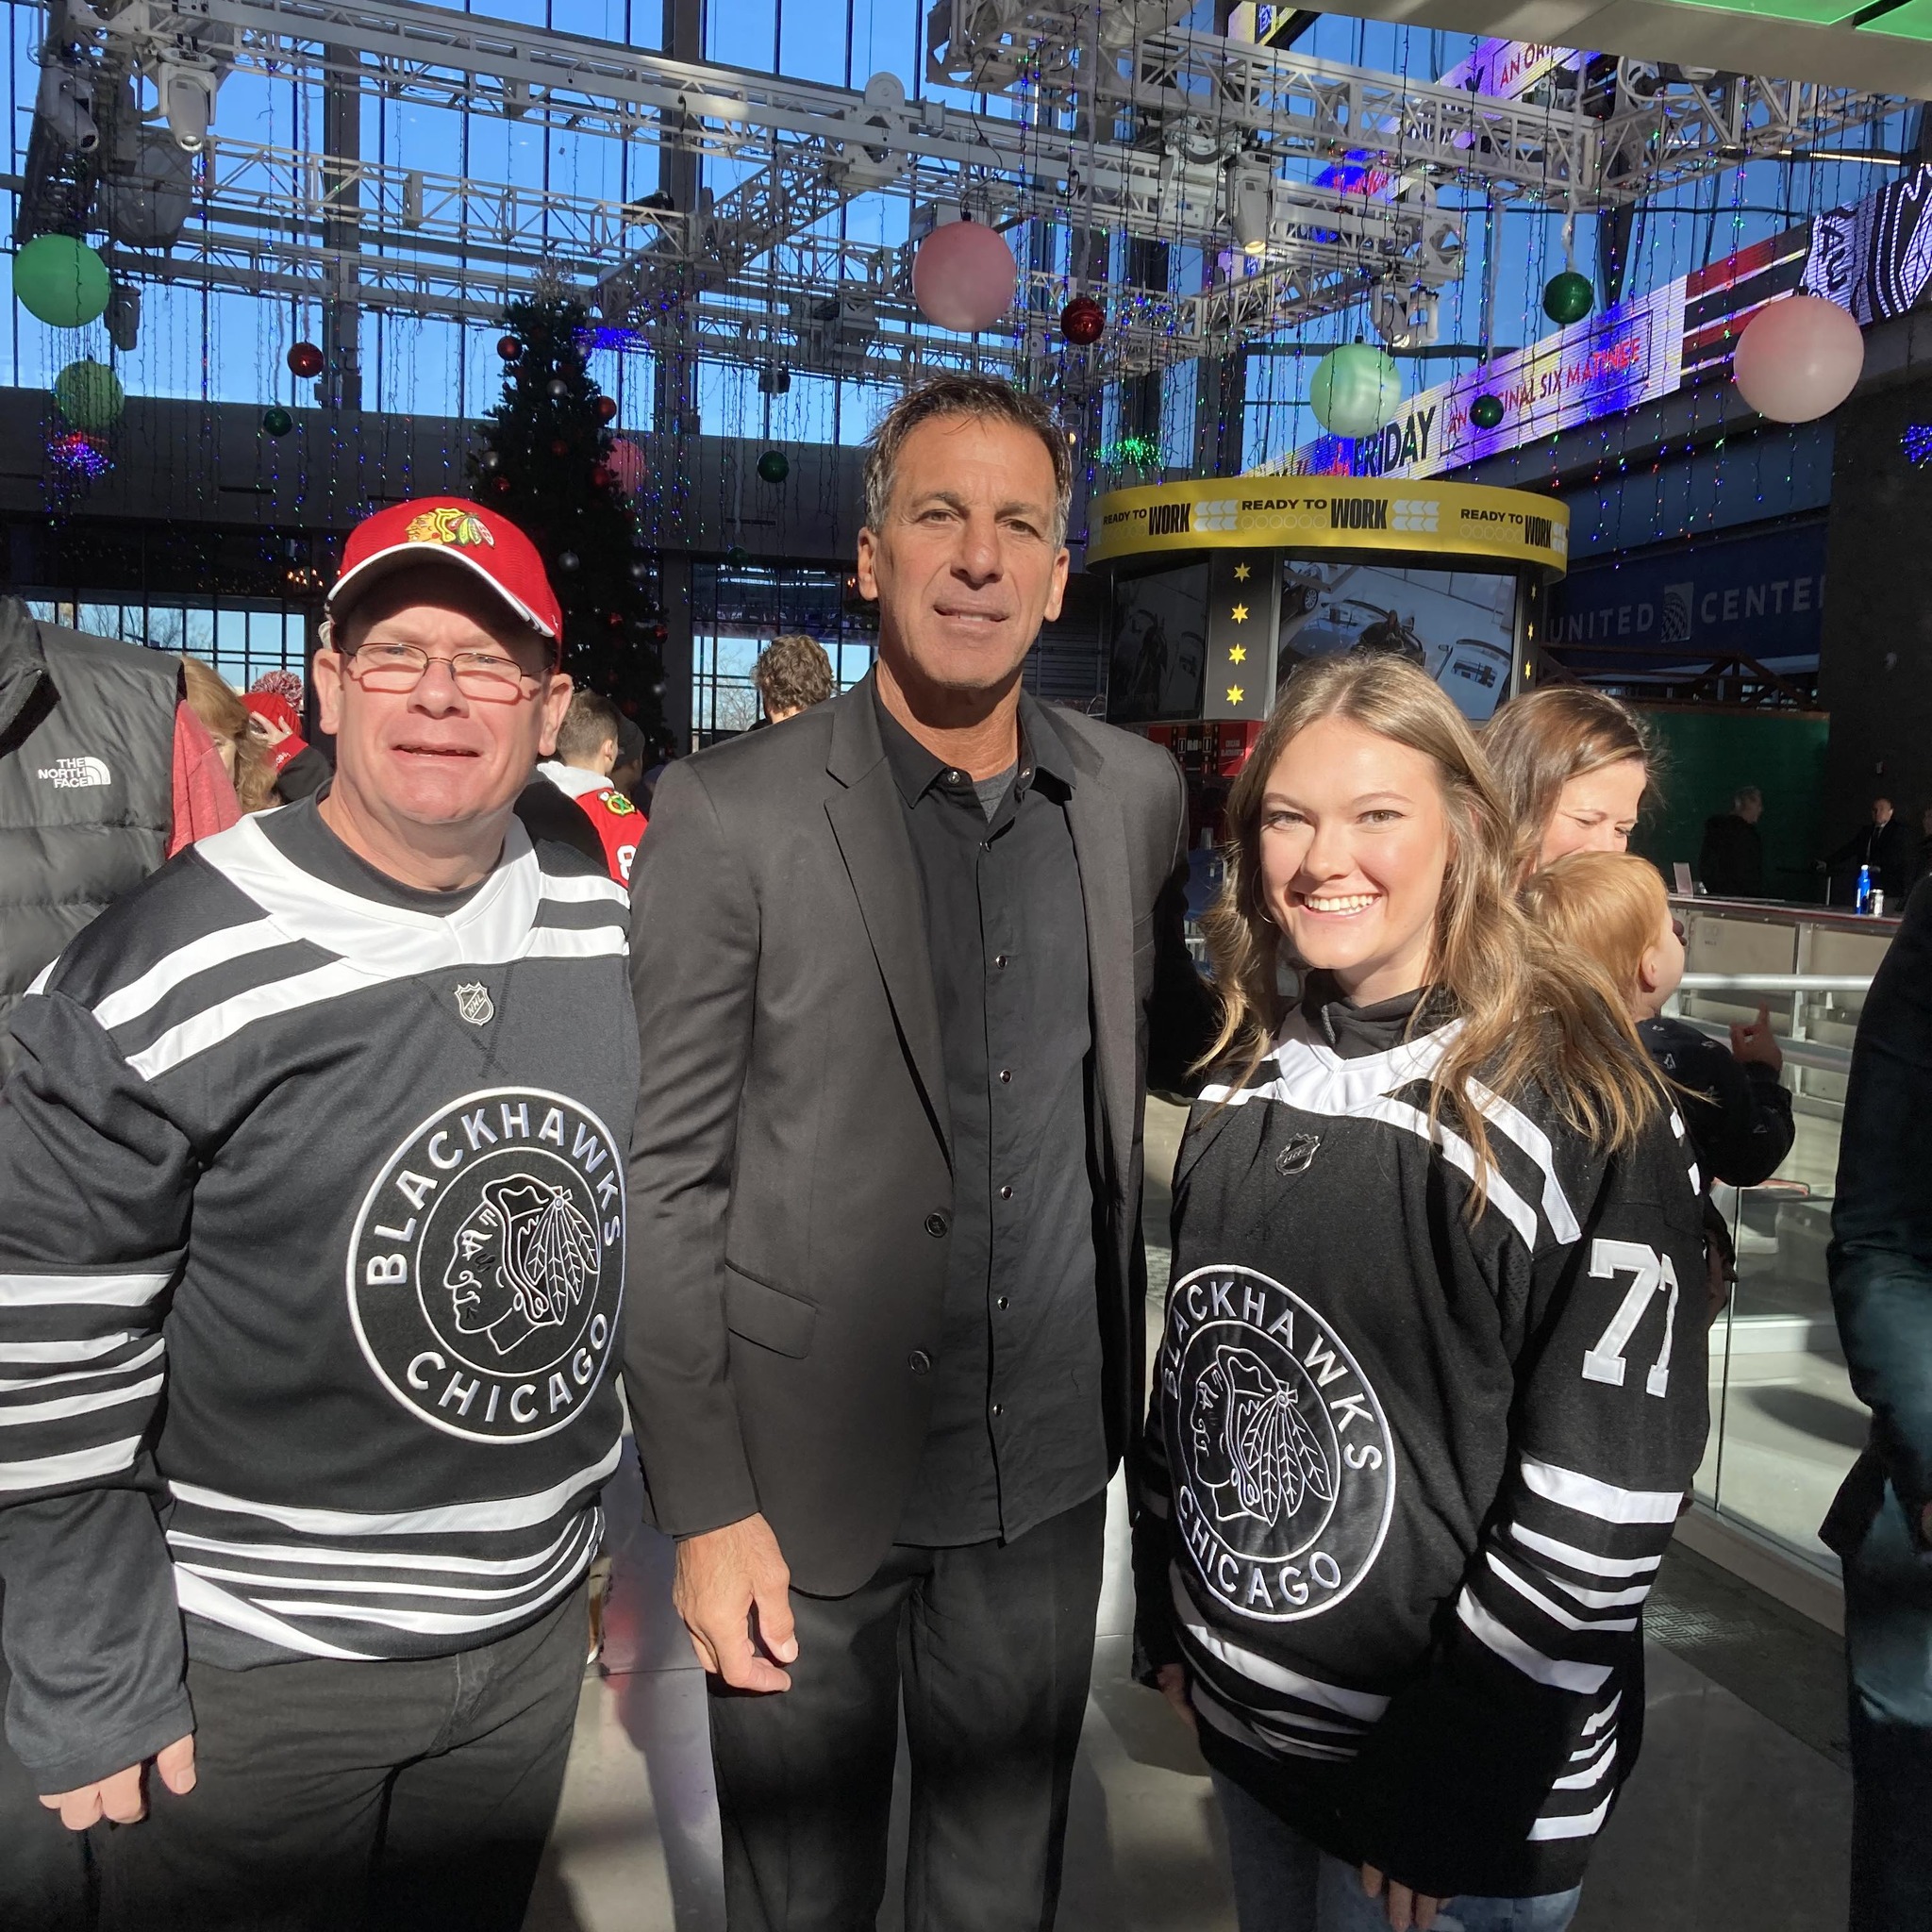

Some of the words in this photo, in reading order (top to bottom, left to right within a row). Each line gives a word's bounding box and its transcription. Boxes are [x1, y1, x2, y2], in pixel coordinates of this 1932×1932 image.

[1500, 53, 1521, 90] AN
[1541, 369, 1562, 399] SIX
[1566, 337, 1641, 390] MATINEE
[1354, 406, 1437, 477] FRIDAY
[1103, 510, 1131, 526] READY
[1133, 508, 1147, 520] TO
[1148, 502, 1191, 536] WORK
[1241, 499, 1300, 510] READY
[1303, 499, 1327, 509] TO
[1330, 498, 1389, 529] WORK
[1460, 508, 1507, 523] READY
[1508, 513, 1524, 525] TO
[1524, 515, 1553, 549] WORK
[1549, 603, 1655, 643] UNITED
[38, 767, 86, 779] NORTH
[54, 776, 88, 789] FACE
[56, 758, 85, 769] THE
[467, 993, 485, 1017] NHL
[366, 1101, 624, 1287] BLACKHAWKS
[1581, 1238, 1679, 1398] 77
[406, 1312, 608, 1424] CHICAGO
[1163, 1280, 1384, 1472] BLACKHAWKS
[1179, 1484, 1341, 1607] CHICAGO
